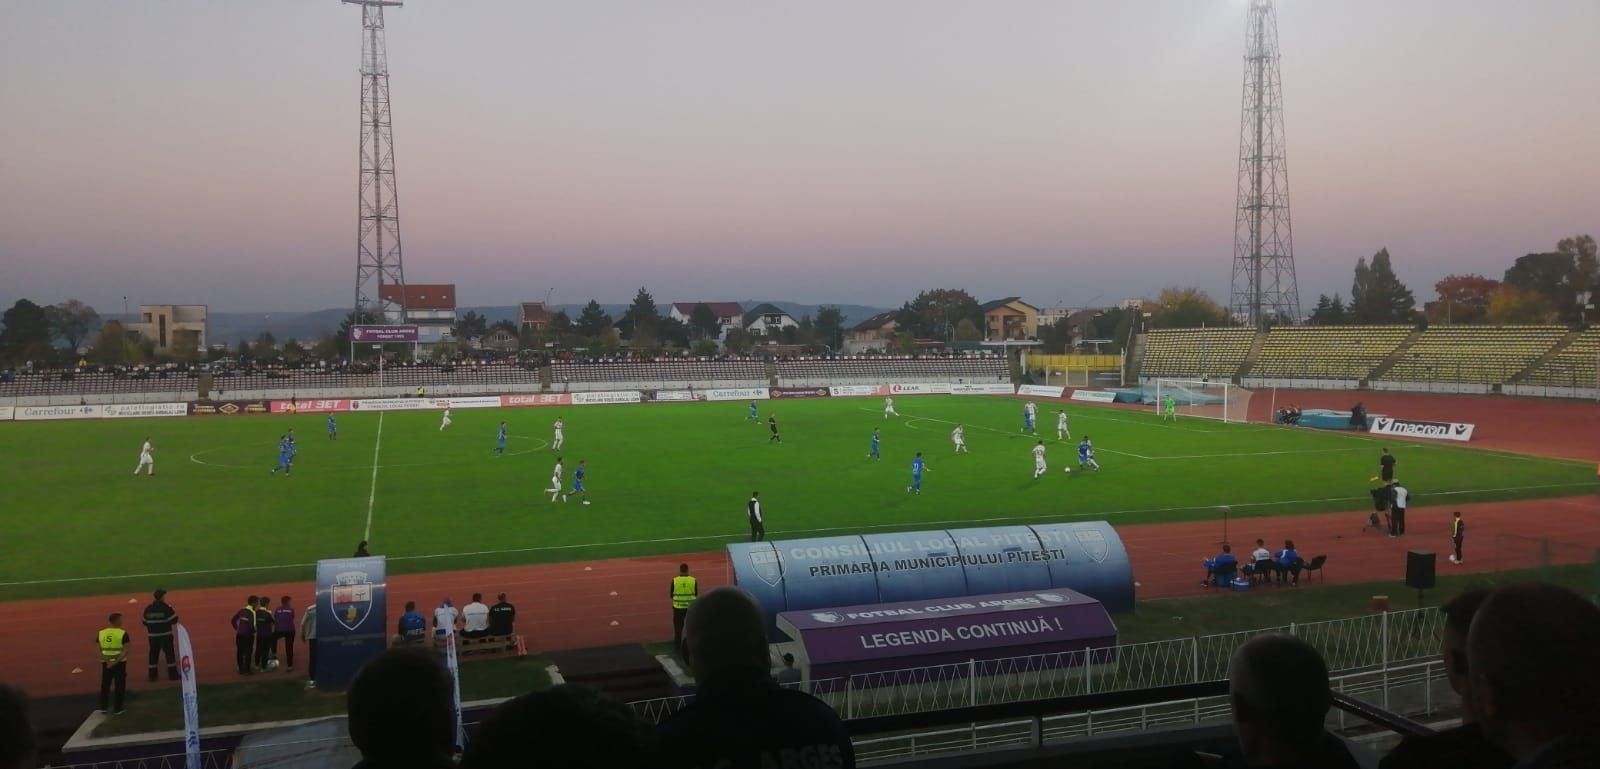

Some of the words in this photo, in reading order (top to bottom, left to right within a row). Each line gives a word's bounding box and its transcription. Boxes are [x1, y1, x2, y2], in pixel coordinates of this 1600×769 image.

[508, 394, 535, 404] total
[24, 406, 76, 416] Carrefour
[1393, 422, 1447, 434] macron
[790, 540, 913, 560] CONSILIUL
[914, 534, 987, 552] LOCAL
[894, 552, 1003, 572] MUNICIPIULUI
[847, 607, 924, 620] FOTBAL
[924, 603, 977, 613] CLUB
[860, 627, 955, 649] LEGENDA
[956, 616, 1053, 640] CONTINUĂ
[1055, 617, 1064, 631] !
